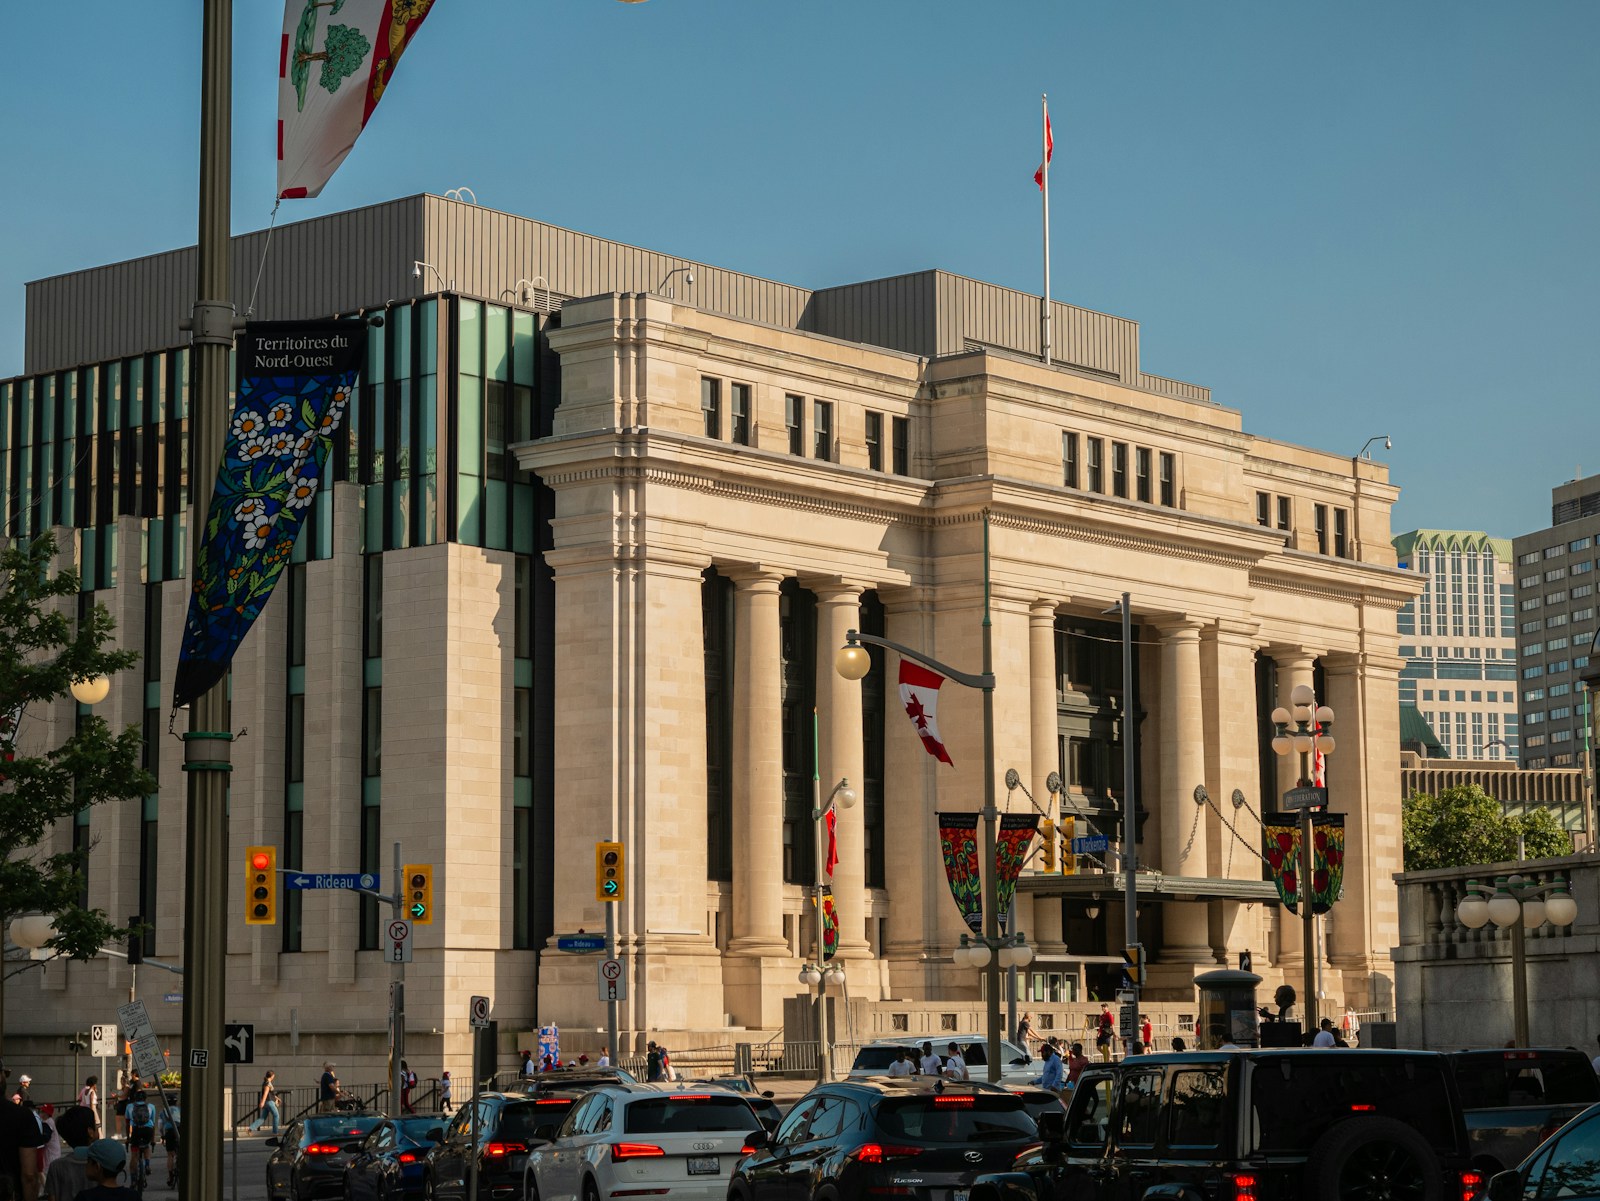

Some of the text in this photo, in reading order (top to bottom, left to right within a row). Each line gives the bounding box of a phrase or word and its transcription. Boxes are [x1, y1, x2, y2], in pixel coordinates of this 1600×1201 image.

[256, 335, 348, 350] Territoires du
[255, 355, 333, 367] Nord-Ouest
[1080, 836, 1107, 853] Mackenzie
[315, 875, 354, 889] Rideau
